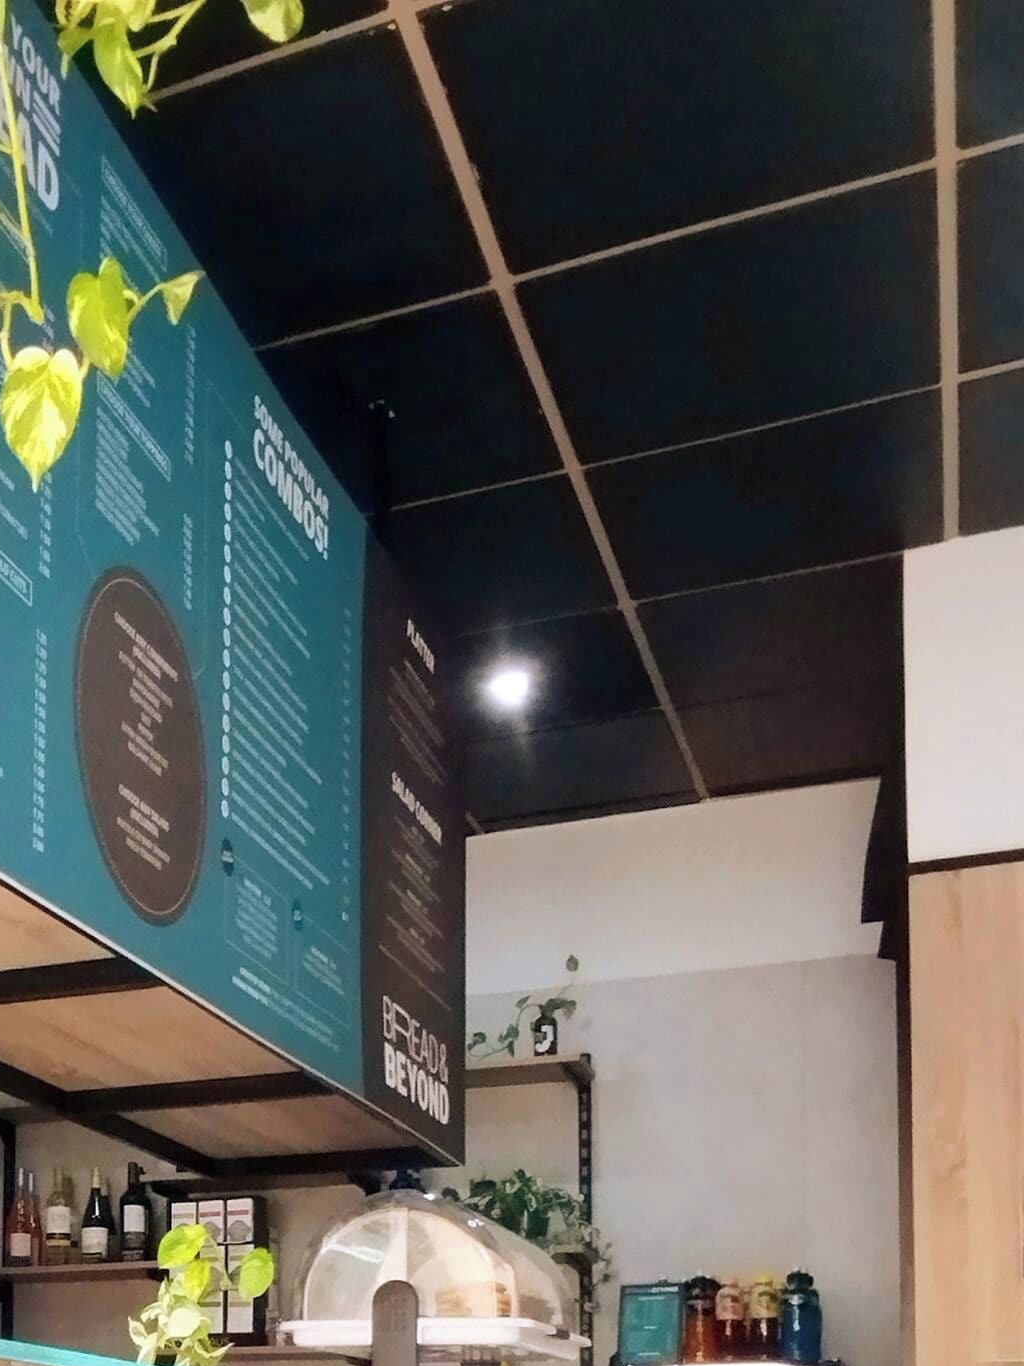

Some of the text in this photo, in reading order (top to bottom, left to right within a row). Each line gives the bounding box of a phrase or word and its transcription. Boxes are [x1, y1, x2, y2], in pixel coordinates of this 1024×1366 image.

[10, 12, 61, 117] YOUR
[253, 428, 329, 561] COMBOS!
[254, 394, 329, 520] SOME POPULAR
[383, 1040, 450, 1126] BEYOND
